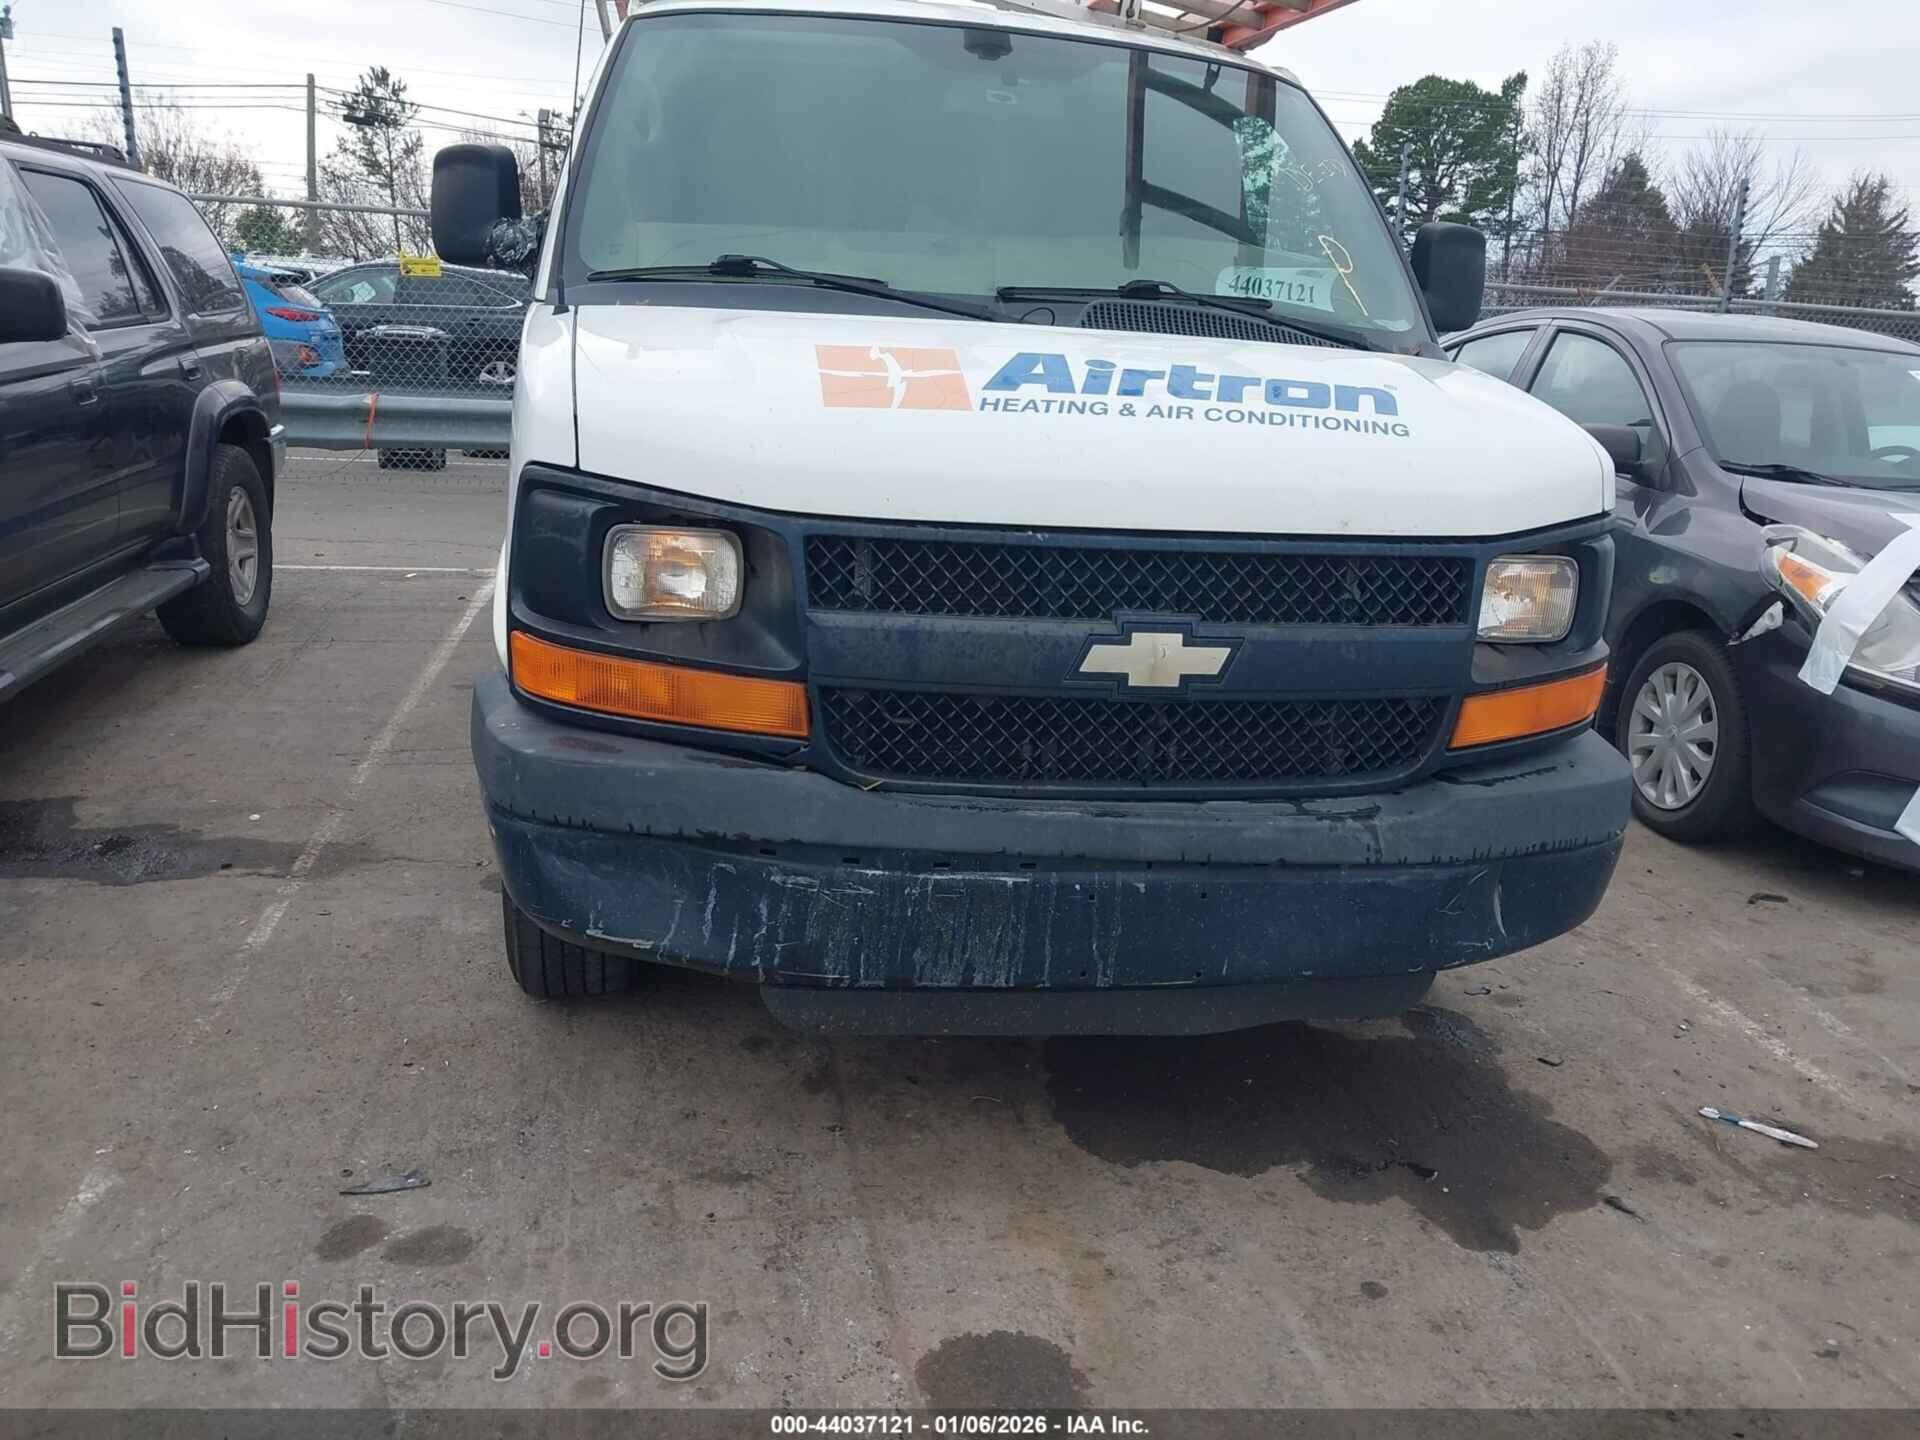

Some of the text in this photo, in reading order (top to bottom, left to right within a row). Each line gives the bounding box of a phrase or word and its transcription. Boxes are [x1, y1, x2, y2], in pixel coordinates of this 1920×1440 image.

[1228, 274, 1315, 303] 44037121
[981, 352, 1399, 416] Airtron
[979, 396, 1410, 438] HEATING & AIR CONDITIONING
